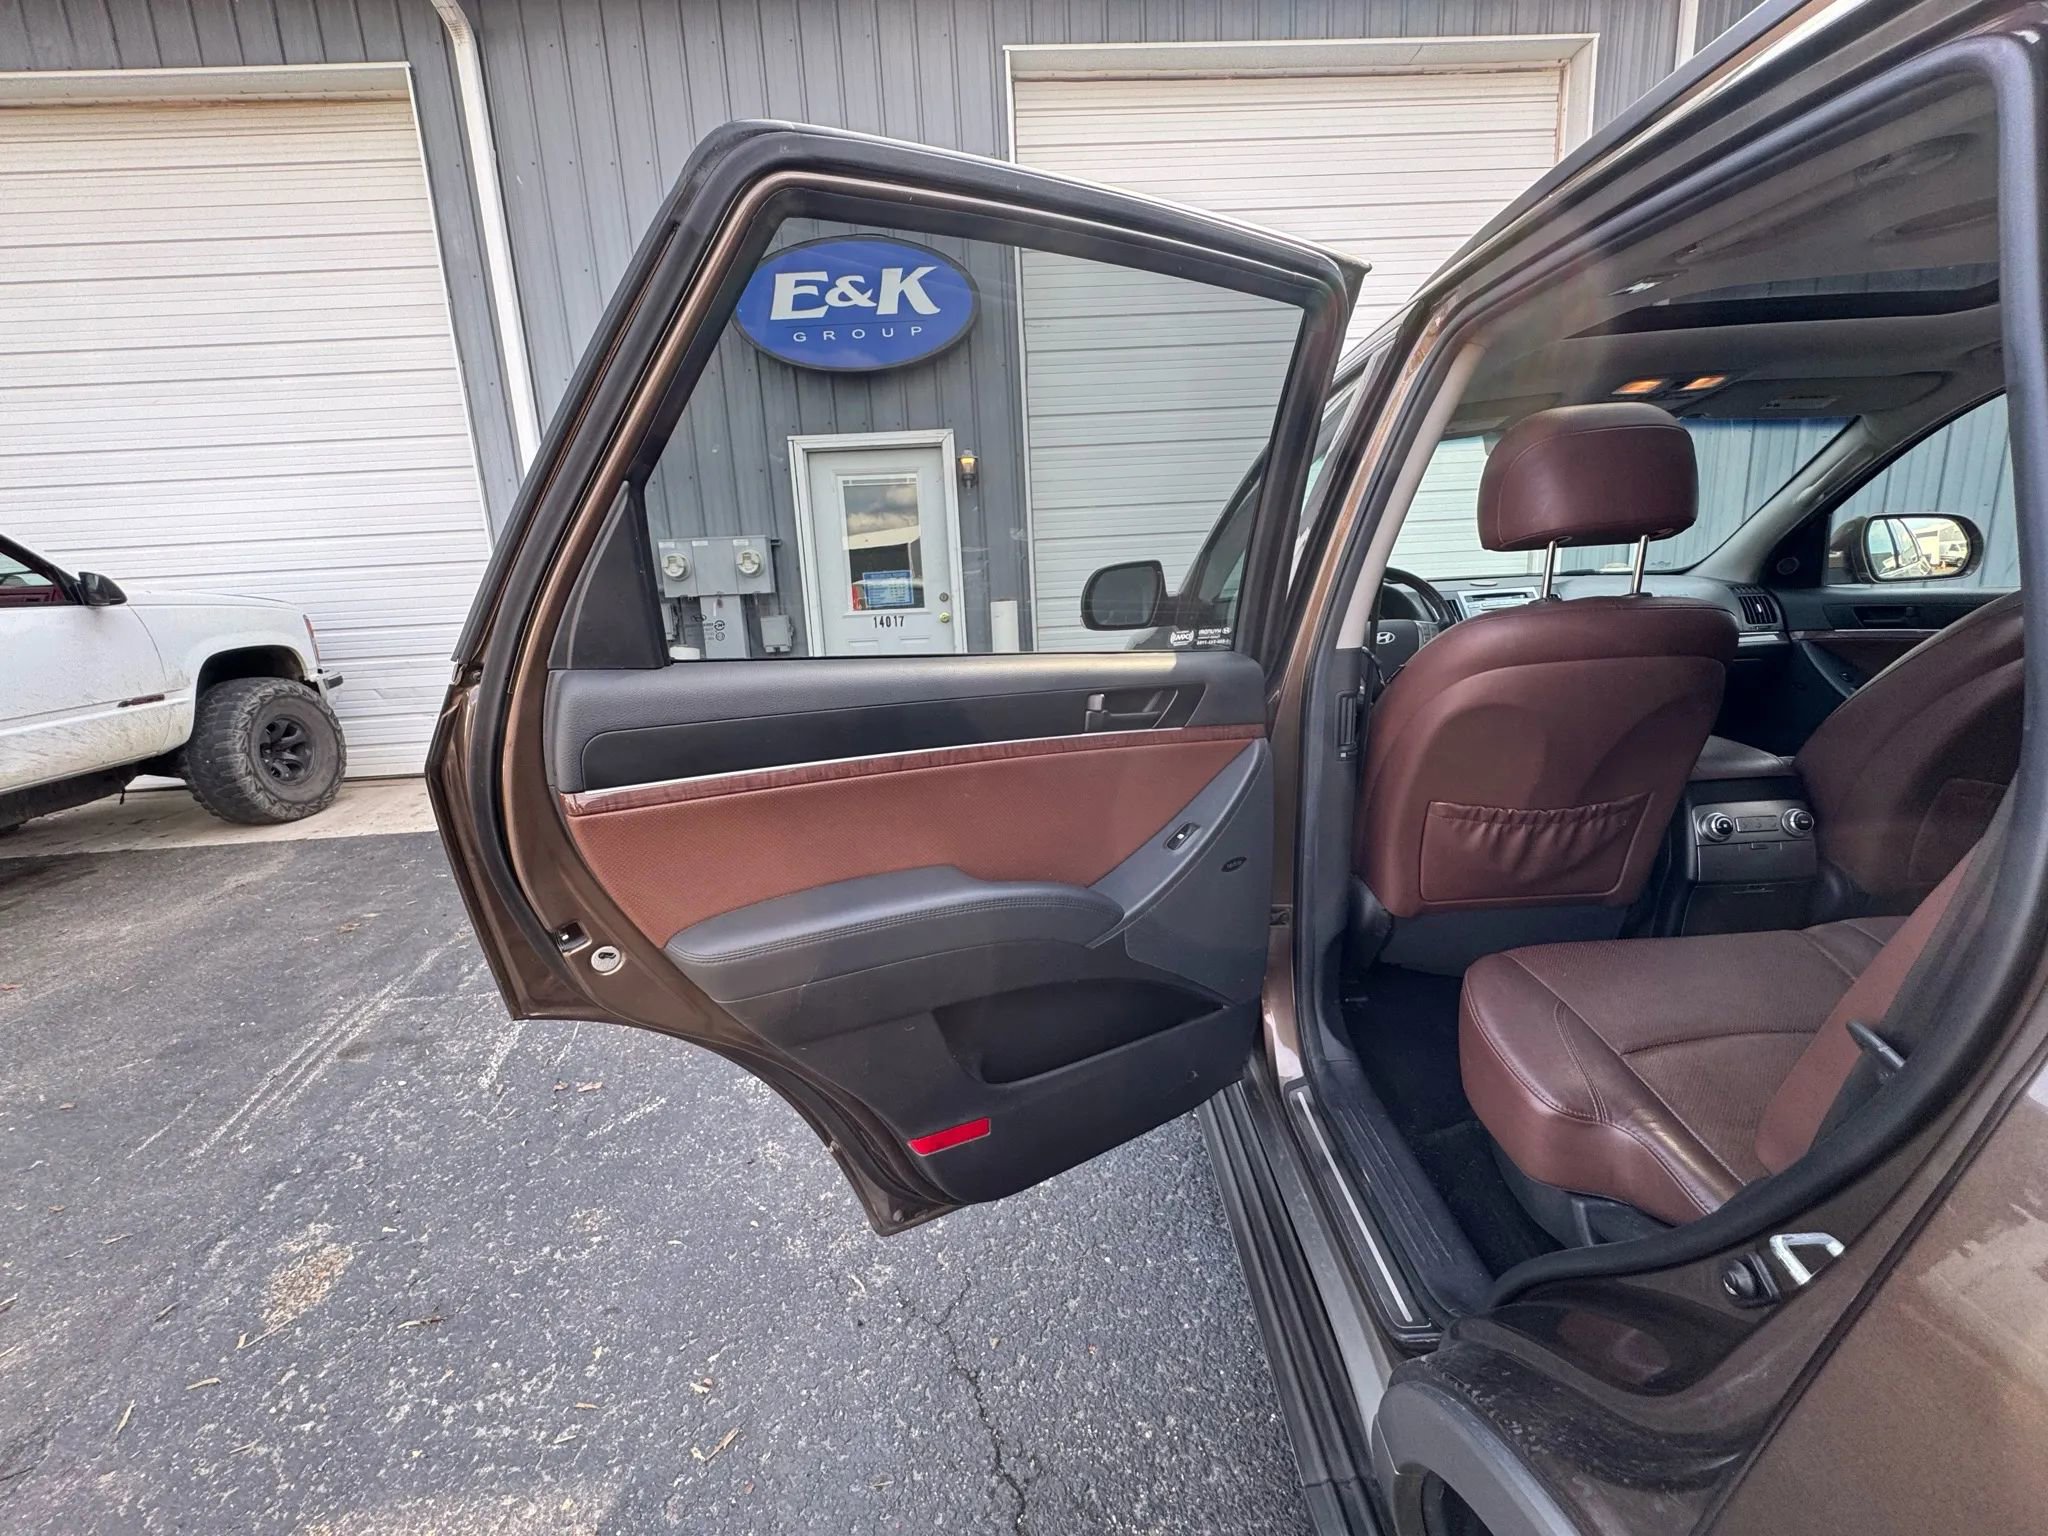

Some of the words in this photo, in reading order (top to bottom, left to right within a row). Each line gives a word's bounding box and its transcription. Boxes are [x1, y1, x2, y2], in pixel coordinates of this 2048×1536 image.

[770, 266, 941, 320] E&K
[793, 326, 922, 342] GROUP
[873, 616, 905, 628] 14017
